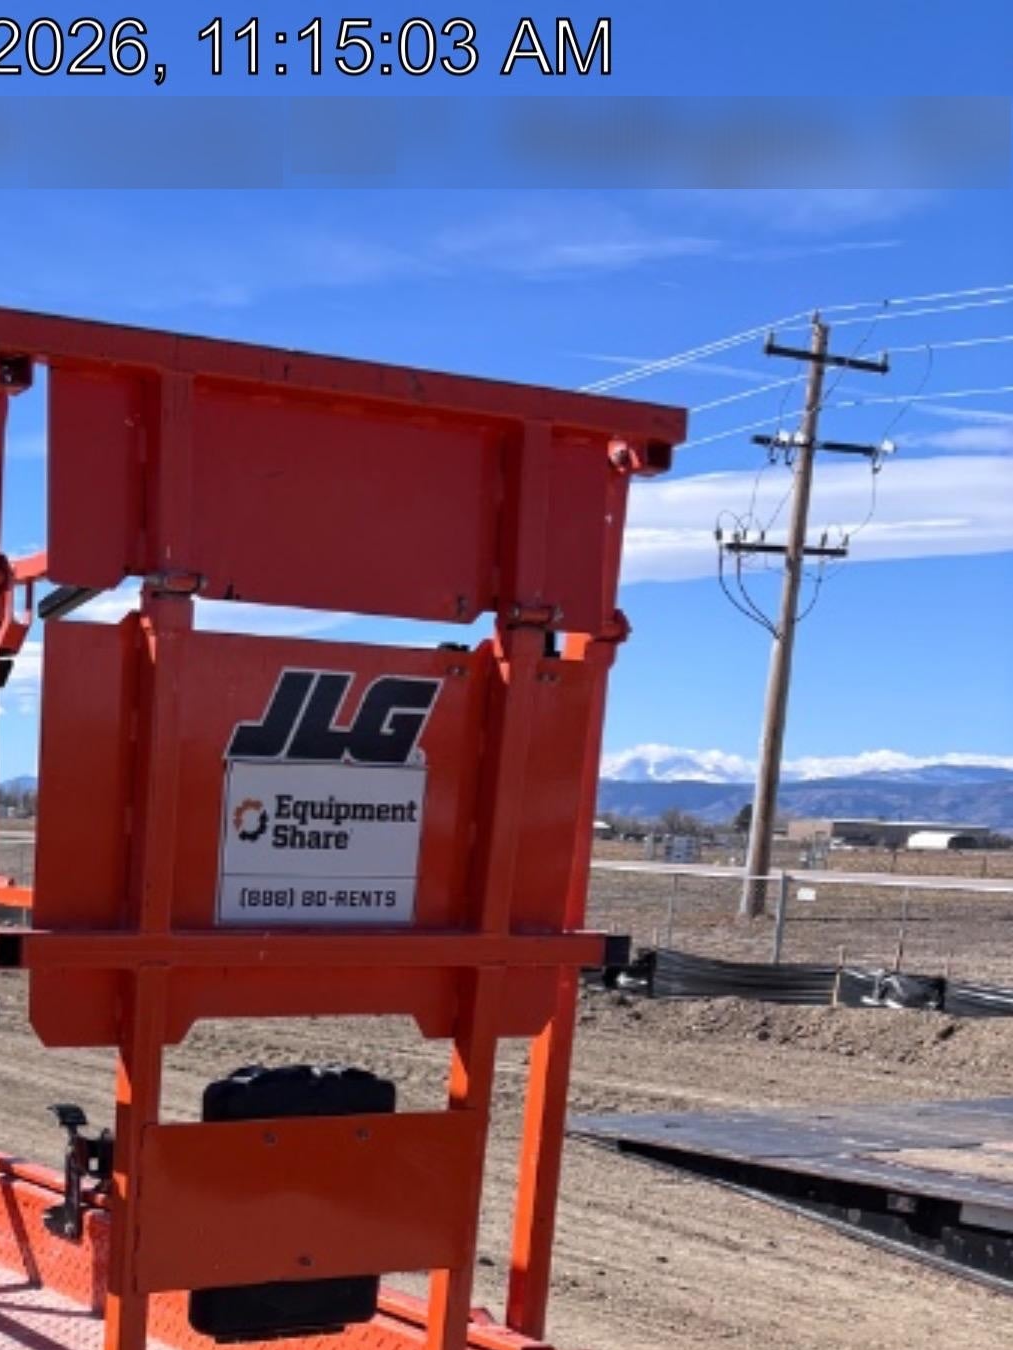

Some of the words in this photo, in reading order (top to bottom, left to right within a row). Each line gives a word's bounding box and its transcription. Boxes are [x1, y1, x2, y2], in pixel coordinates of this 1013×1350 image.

[226, 668, 440, 764] JLG
[274, 794, 418, 826] Equipment
[271, 825, 349, 850] Share
[301, 889, 397, 908] 80-RENTS
